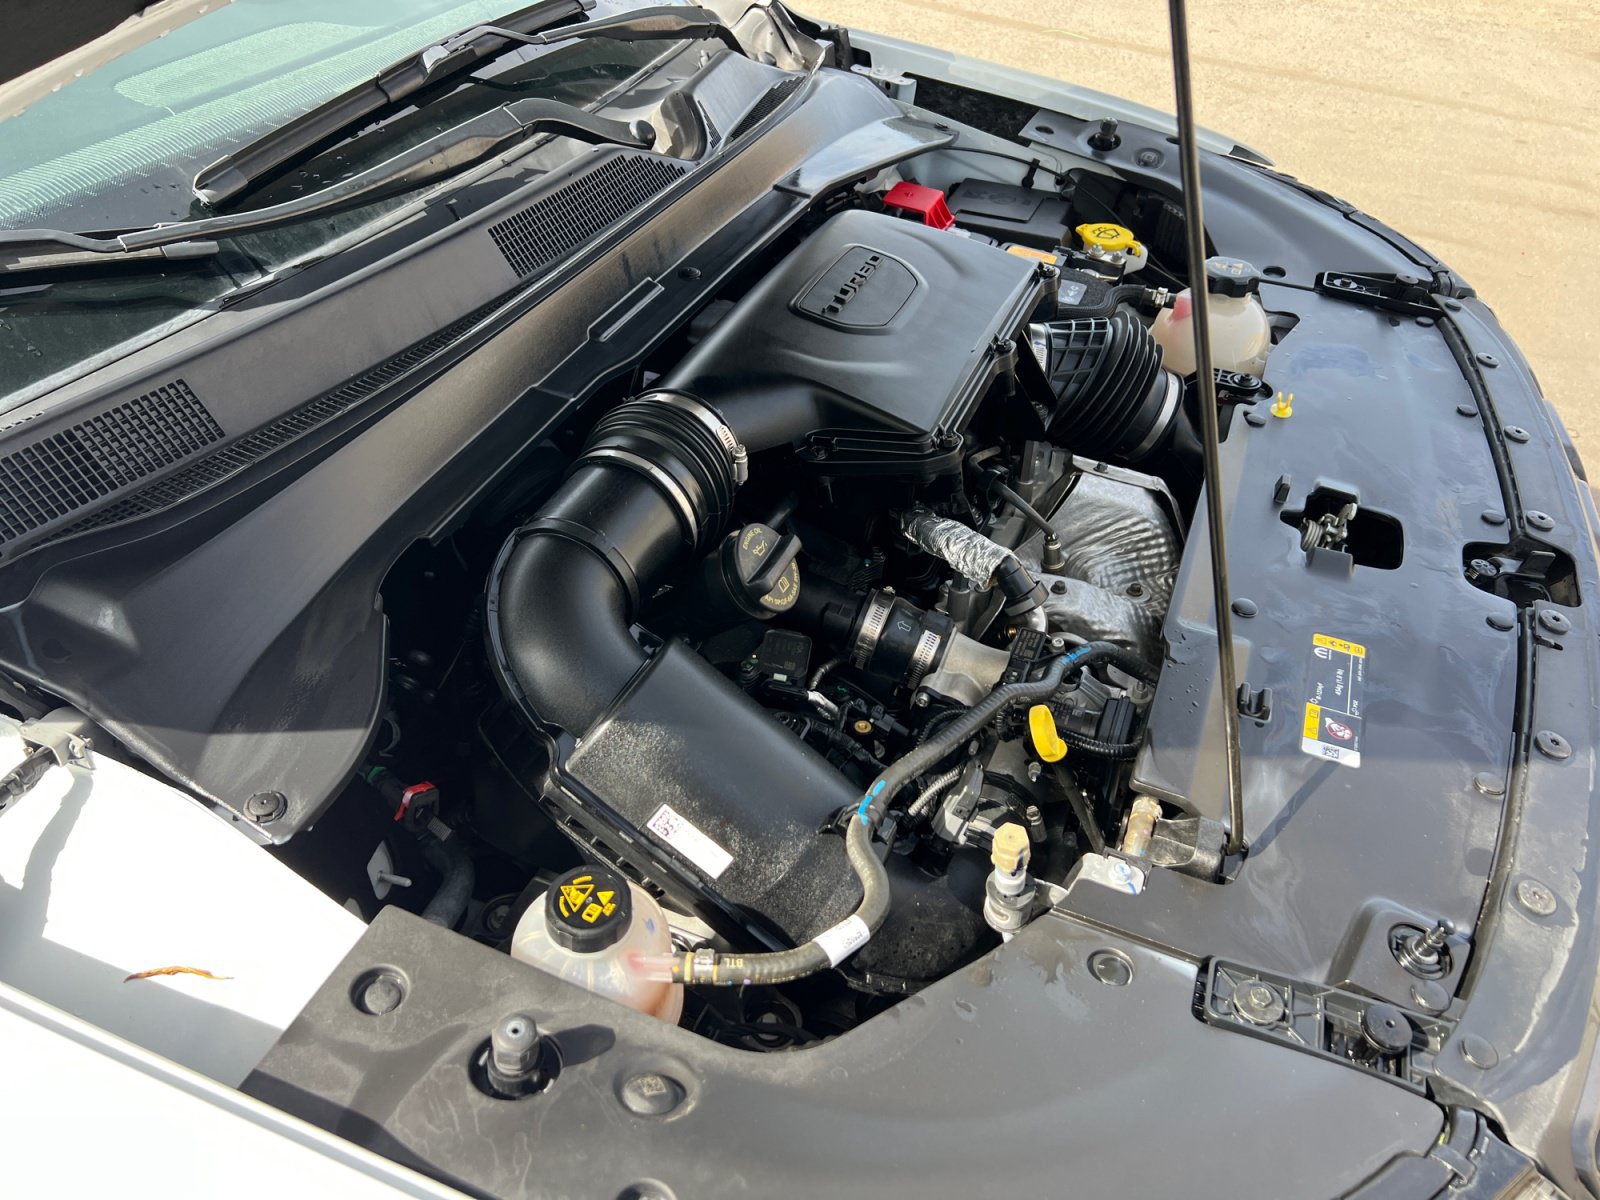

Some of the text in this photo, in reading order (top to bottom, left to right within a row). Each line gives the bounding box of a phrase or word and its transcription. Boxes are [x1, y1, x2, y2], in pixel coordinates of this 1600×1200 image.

[822, 255, 882, 315] TURBO
[742, 532, 754, 550] ENGINE
[723, 957, 744, 969] BTL
